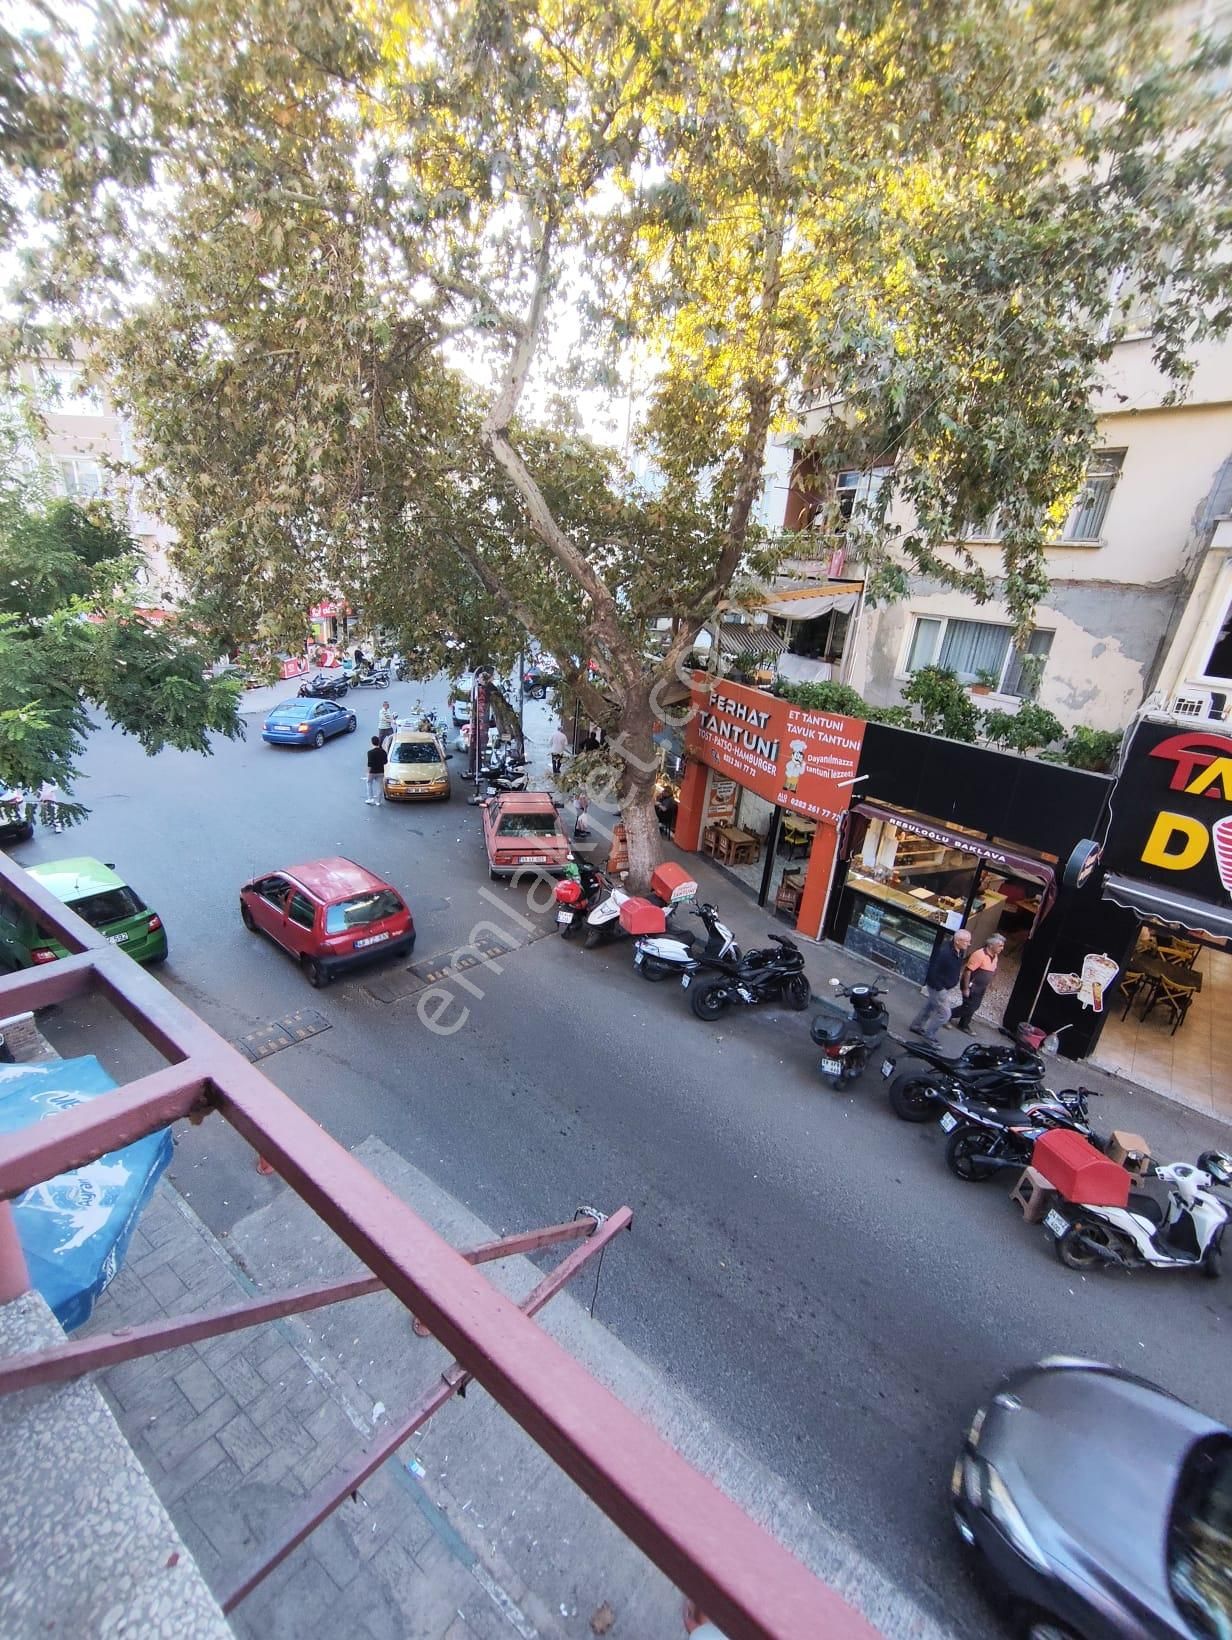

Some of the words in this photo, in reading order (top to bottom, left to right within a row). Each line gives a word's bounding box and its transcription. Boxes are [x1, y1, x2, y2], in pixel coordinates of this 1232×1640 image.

[709, 693, 769, 728] FERHAT
[789, 710, 800, 721] ET
[802, 713, 844, 731] TANTUNİ
[699, 710, 779, 762] TANTUNİ
[787, 723, 816, 739] TAVUK
[818, 732, 861, 751] TANTUNİ
[954, 841, 1006, 862] BAKLAVA
